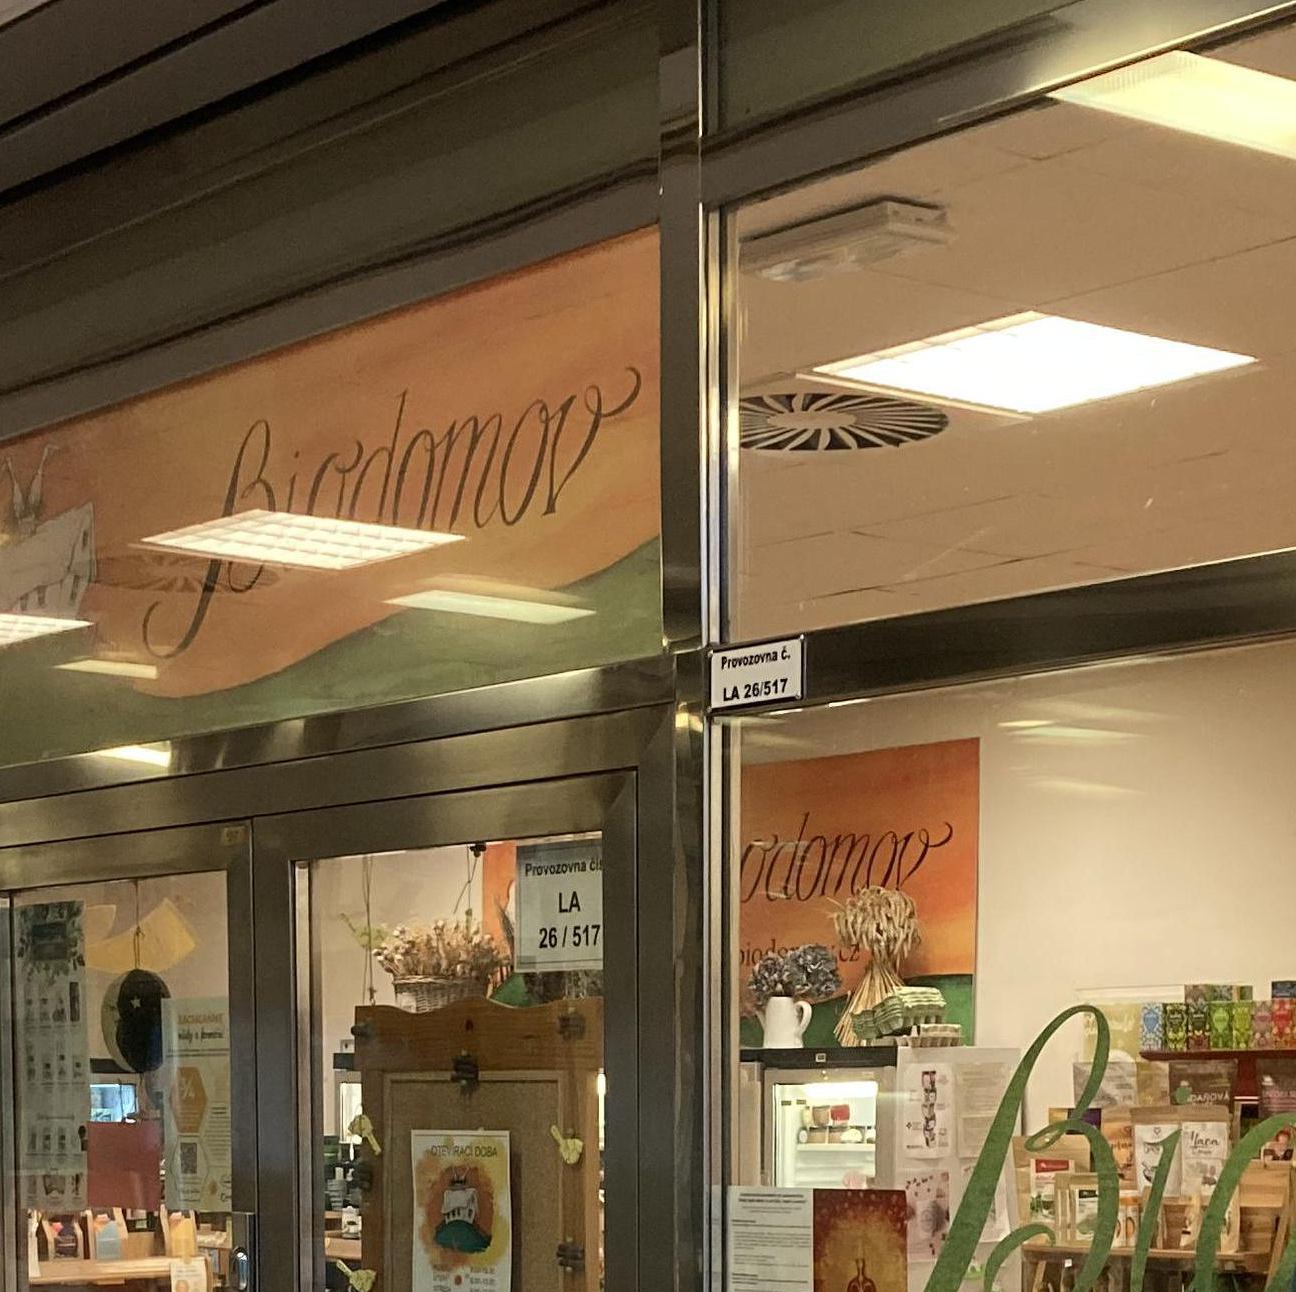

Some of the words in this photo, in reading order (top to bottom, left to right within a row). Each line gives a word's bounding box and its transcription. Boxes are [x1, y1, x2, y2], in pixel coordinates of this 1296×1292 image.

[720, 649, 778, 670] Provozovna
[723, 686, 740, 702] LA
[743, 678, 789, 698] 26/517
[525, 862, 586, 877] Provozovna
[558, 891, 581, 913] LA
[539, 927, 558, 949] 26
[572, 925, 601, 947] 517
